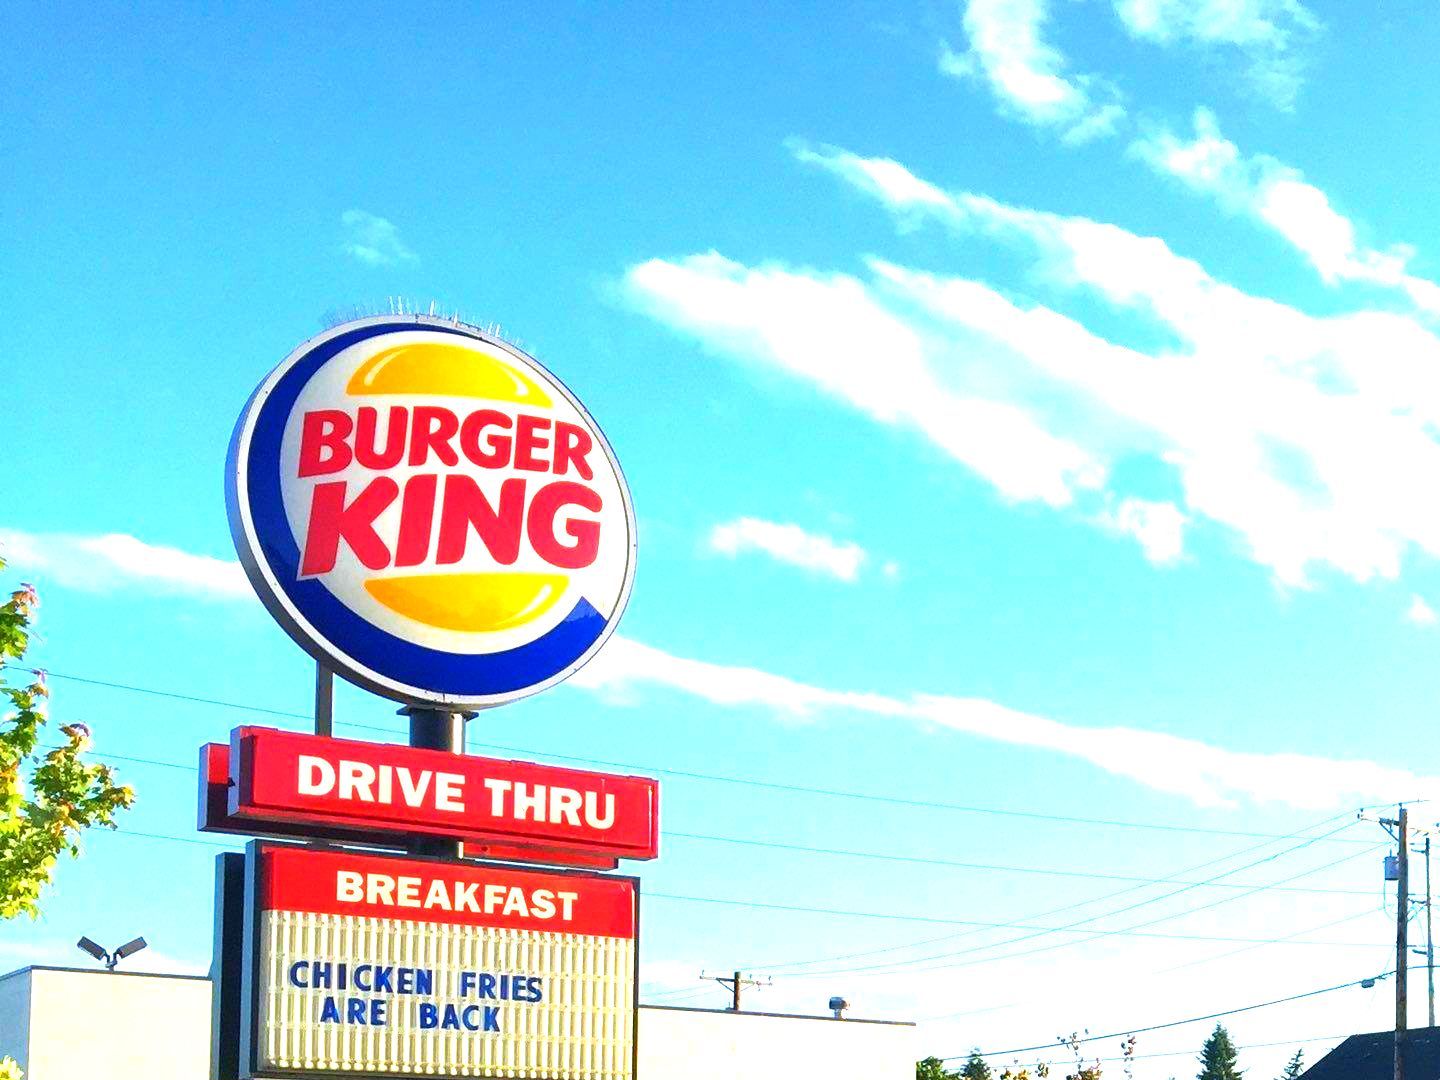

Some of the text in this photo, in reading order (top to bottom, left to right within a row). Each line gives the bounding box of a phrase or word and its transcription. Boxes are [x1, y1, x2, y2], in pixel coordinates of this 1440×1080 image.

[298, 405, 593, 480] BURGER
[301, 474, 603, 575] KING
[298, 755, 615, 830] DRIVE THRU
[336, 870, 578, 921] BREAKFAST
[289, 961, 543, 1003] CHICKEN FRIES
[320, 996, 501, 1032] ARE BACK
